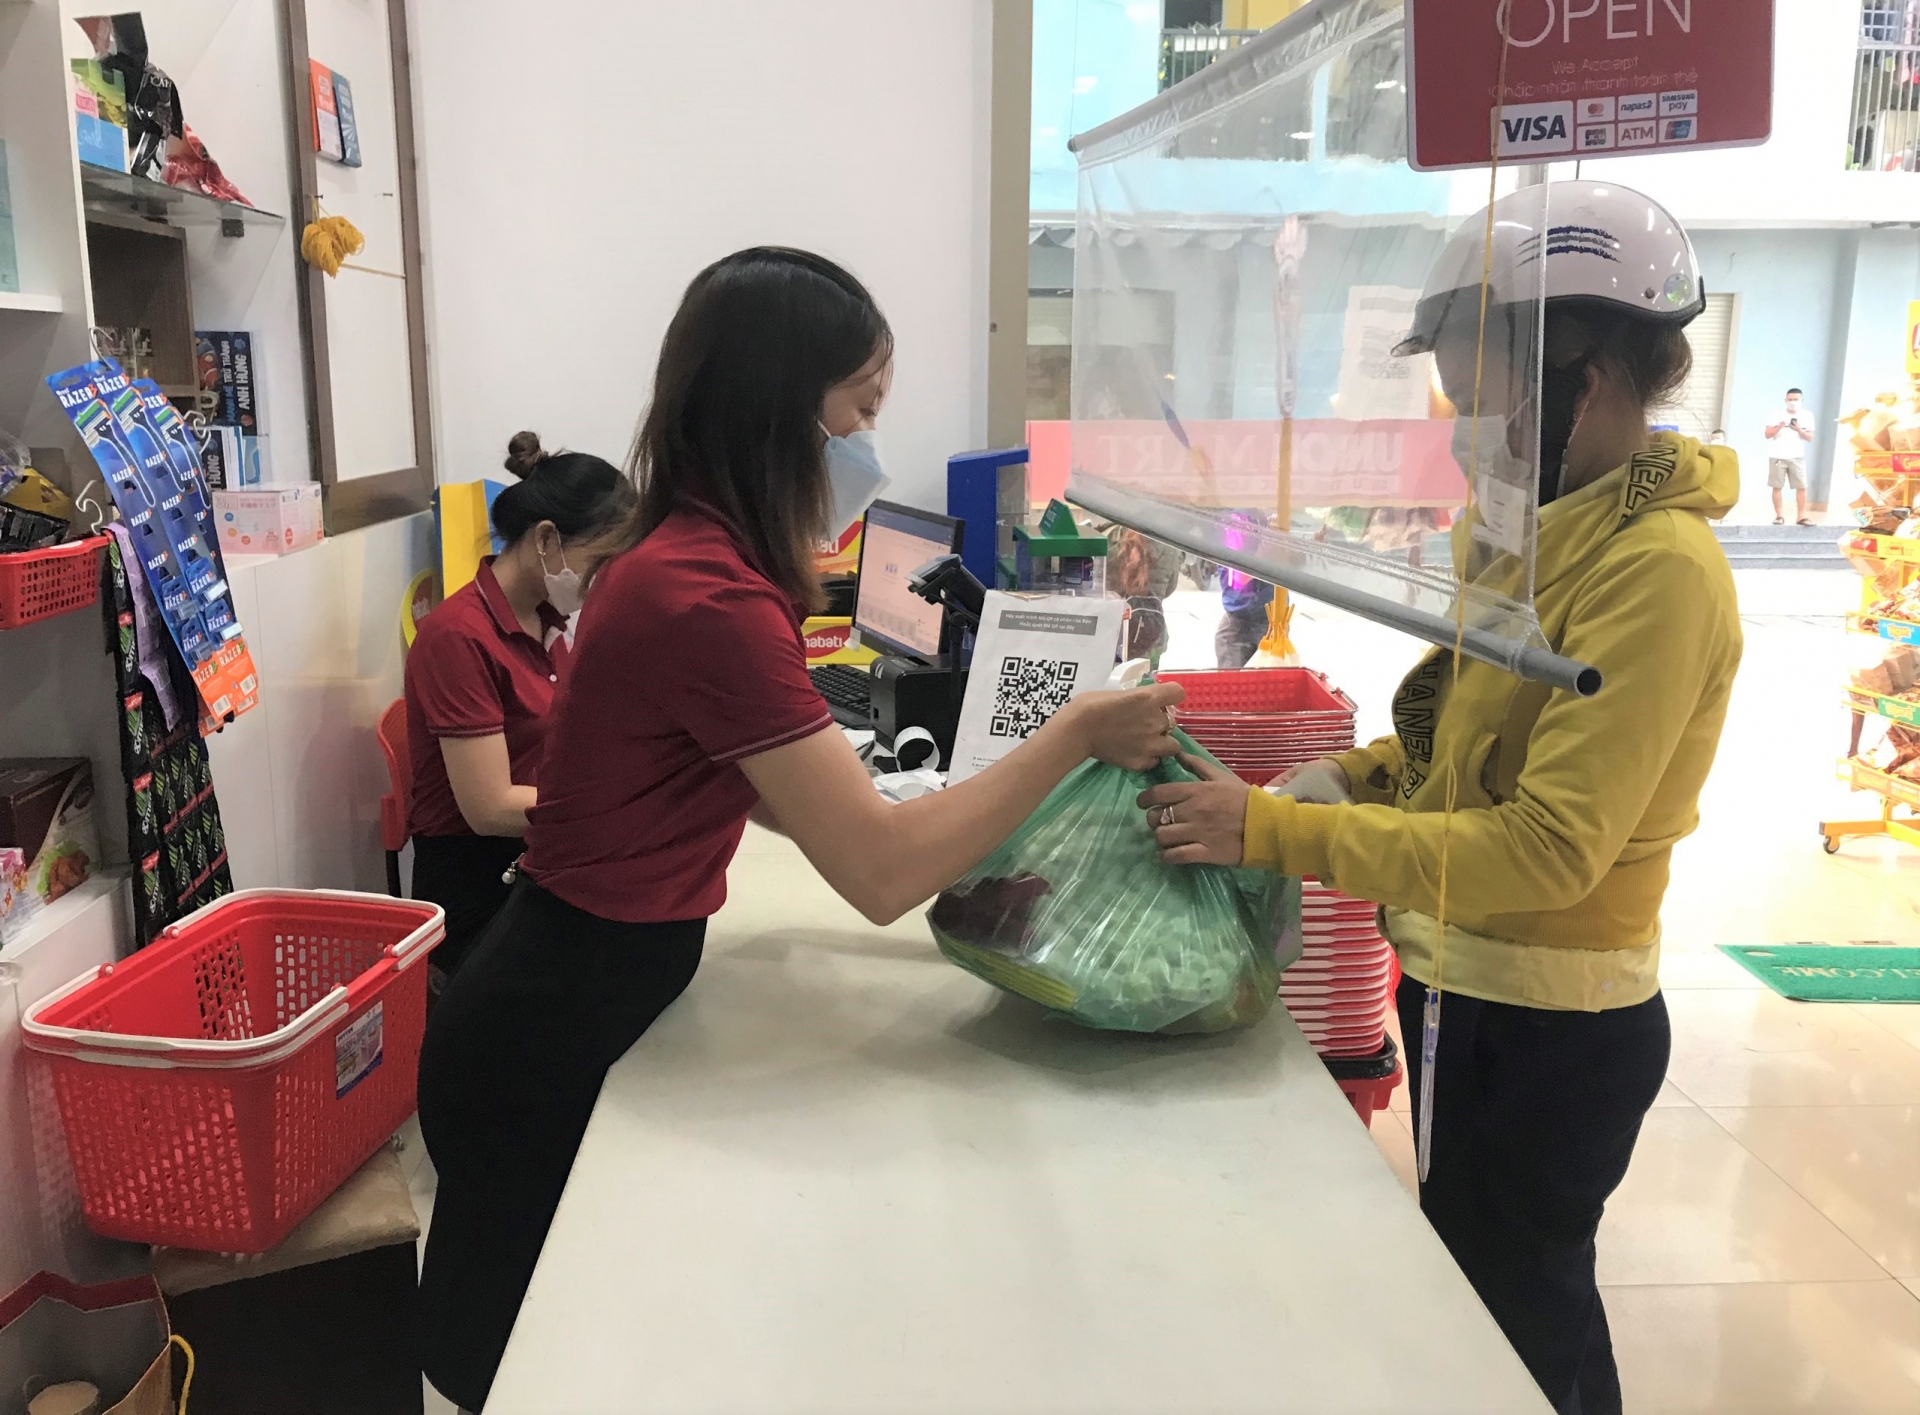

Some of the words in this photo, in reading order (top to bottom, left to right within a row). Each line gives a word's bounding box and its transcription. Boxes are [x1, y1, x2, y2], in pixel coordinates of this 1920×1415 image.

[1496, 0, 1692, 47] OPEN
[1552, 60, 1576, 75] We
[1581, 56, 1640, 71] Accept
[1662, 93, 1695, 102] SAMSUNG
[1668, 101, 1688, 112] pay
[1500, 115, 1567, 143] VISA
[1621, 126, 1653, 142] ATM
[96, 375, 127, 395] RAZER
[59, 386, 94, 409] RAZER
[144, 395, 164, 409] ZER
[237, 386, 251, 410] ANH
[1394, 657, 1441, 764] HANEL
